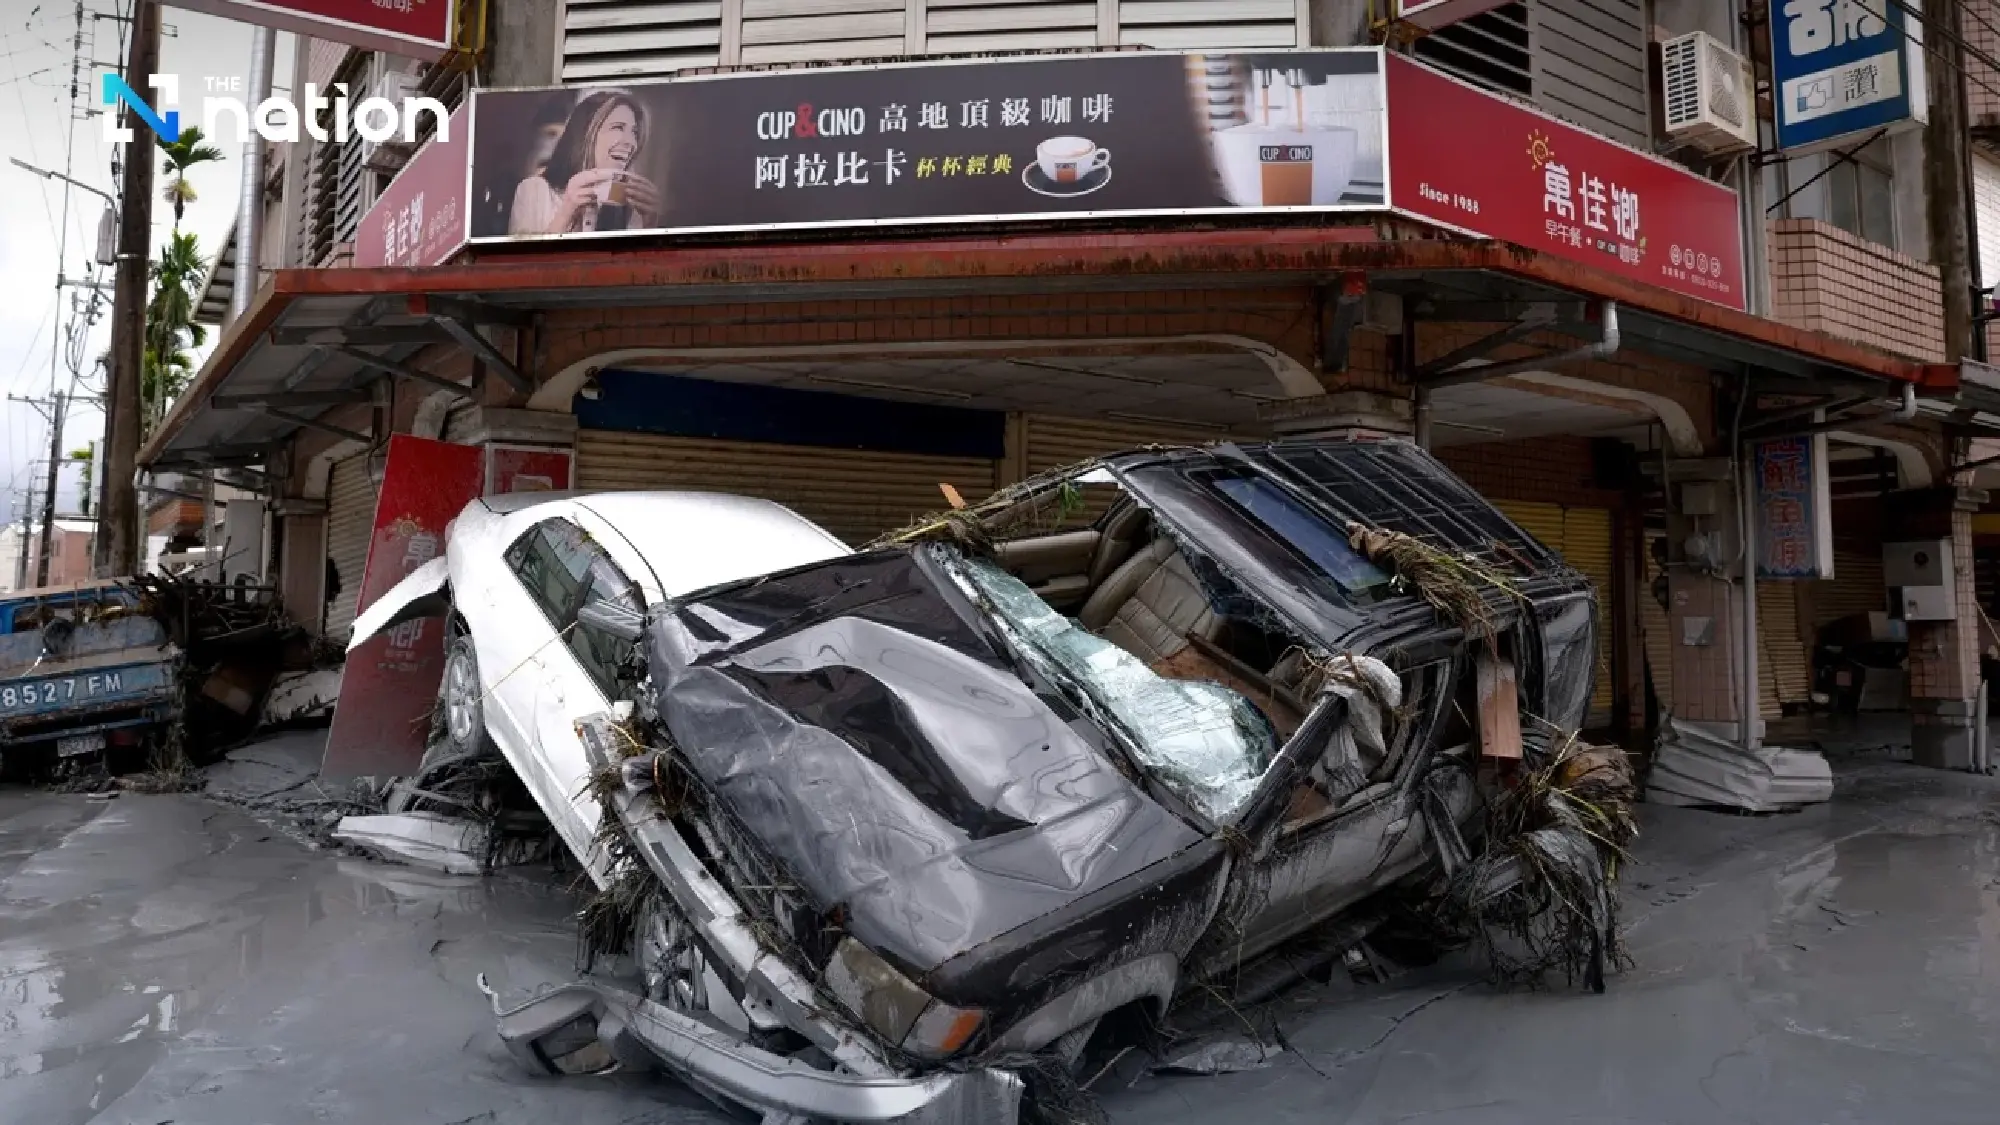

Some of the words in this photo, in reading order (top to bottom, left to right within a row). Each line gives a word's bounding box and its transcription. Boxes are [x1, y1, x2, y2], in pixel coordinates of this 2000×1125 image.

[1843, 64, 1878, 102] 讚
[757, 103, 866, 140] CUP&CINO
[879, 93, 1114, 133] 高地頂級咖啡
[754, 148, 908, 189] 阿拉比卡
[917, 153, 1012, 178] 杯杯經典
[1419, 182, 1449, 205] Since
[1453, 193, 1480, 215] 1988
[2, 679, 76, 707] 8527
[88, 673, 121, 695] FM
